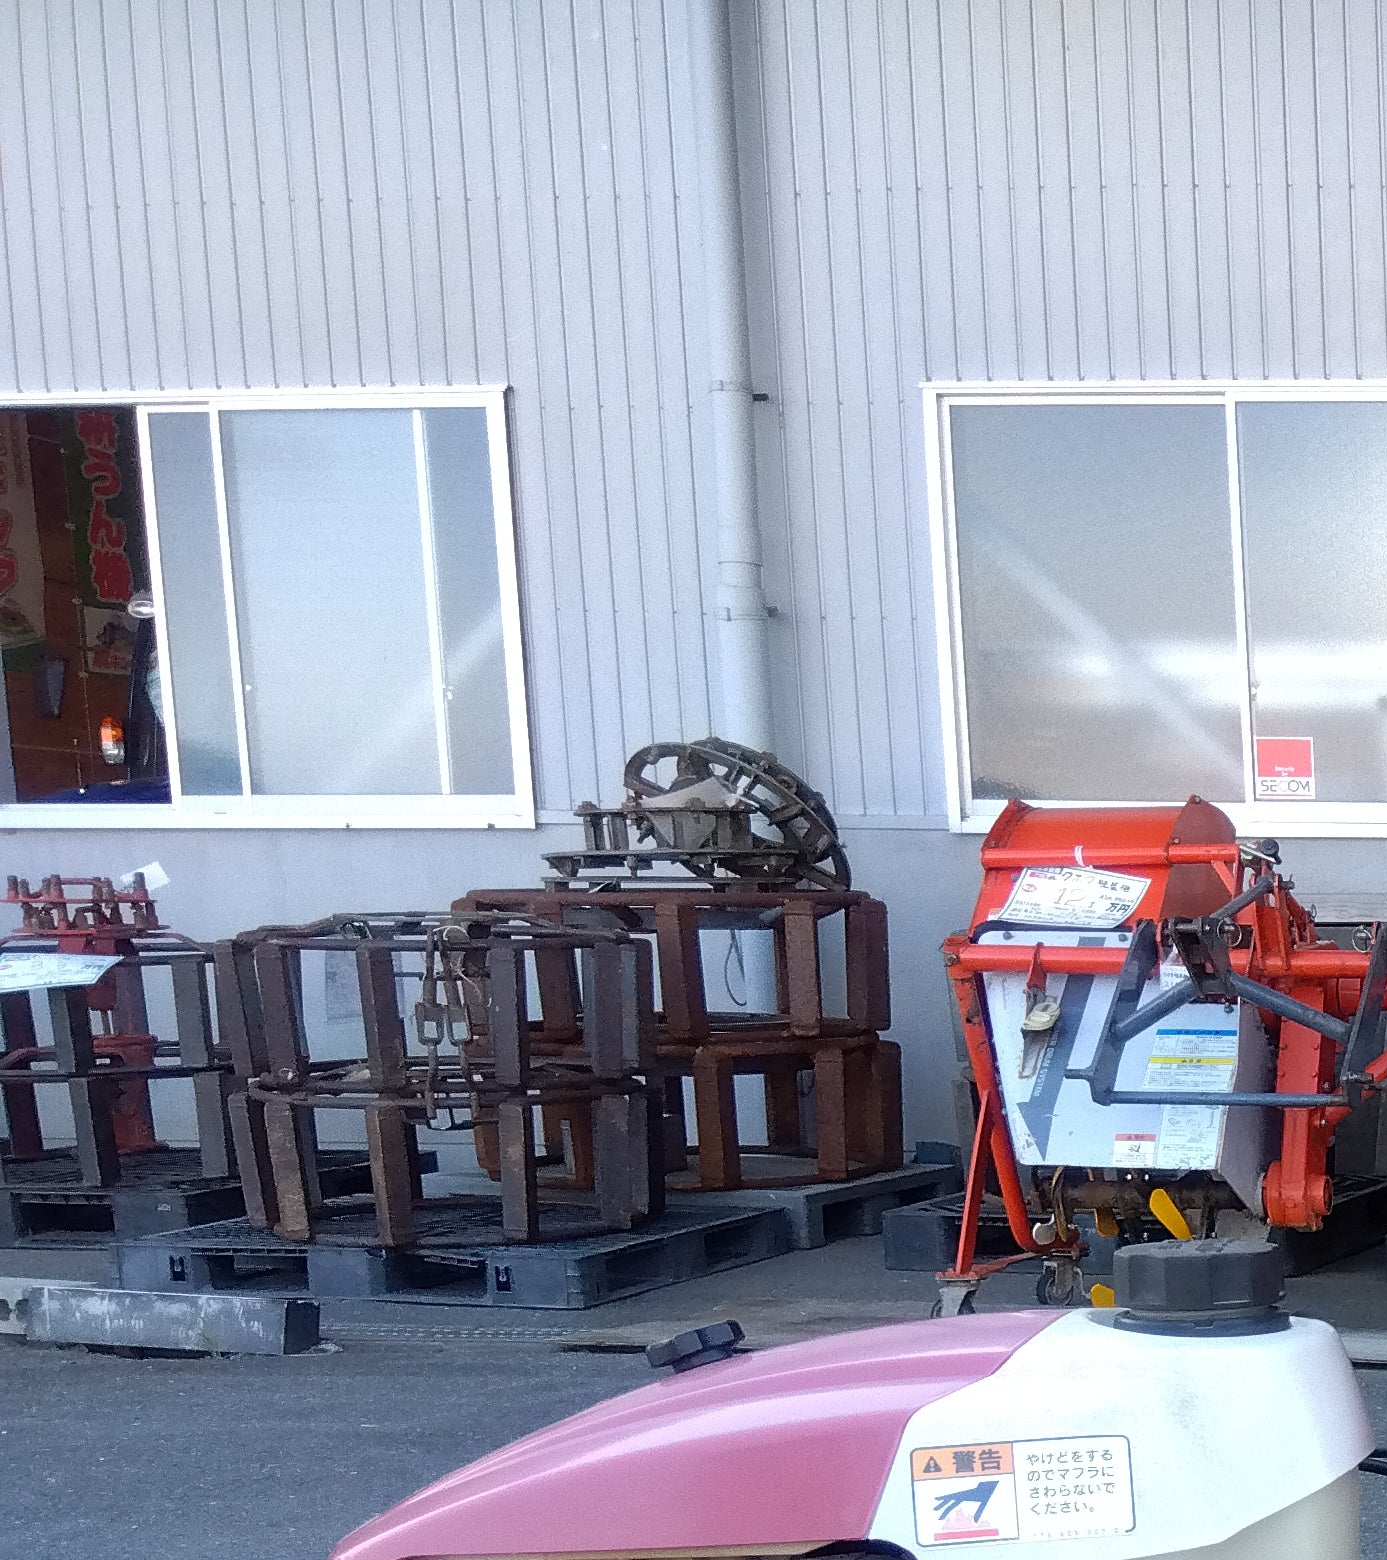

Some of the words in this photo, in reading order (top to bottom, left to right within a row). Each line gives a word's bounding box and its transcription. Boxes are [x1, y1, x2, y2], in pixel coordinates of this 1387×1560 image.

[1260, 779, 1311, 793] SECOM
[1105, 902, 1131, 914] 万円
[952, 1448, 1002, 1474] 警告
[1025, 1449, 1113, 1466] やけどをする
[1027, 1466, 1115, 1482] のでマフラに
[1029, 1482, 1116, 1499] さわらないで
[1030, 1502, 1095, 1516] ください。
